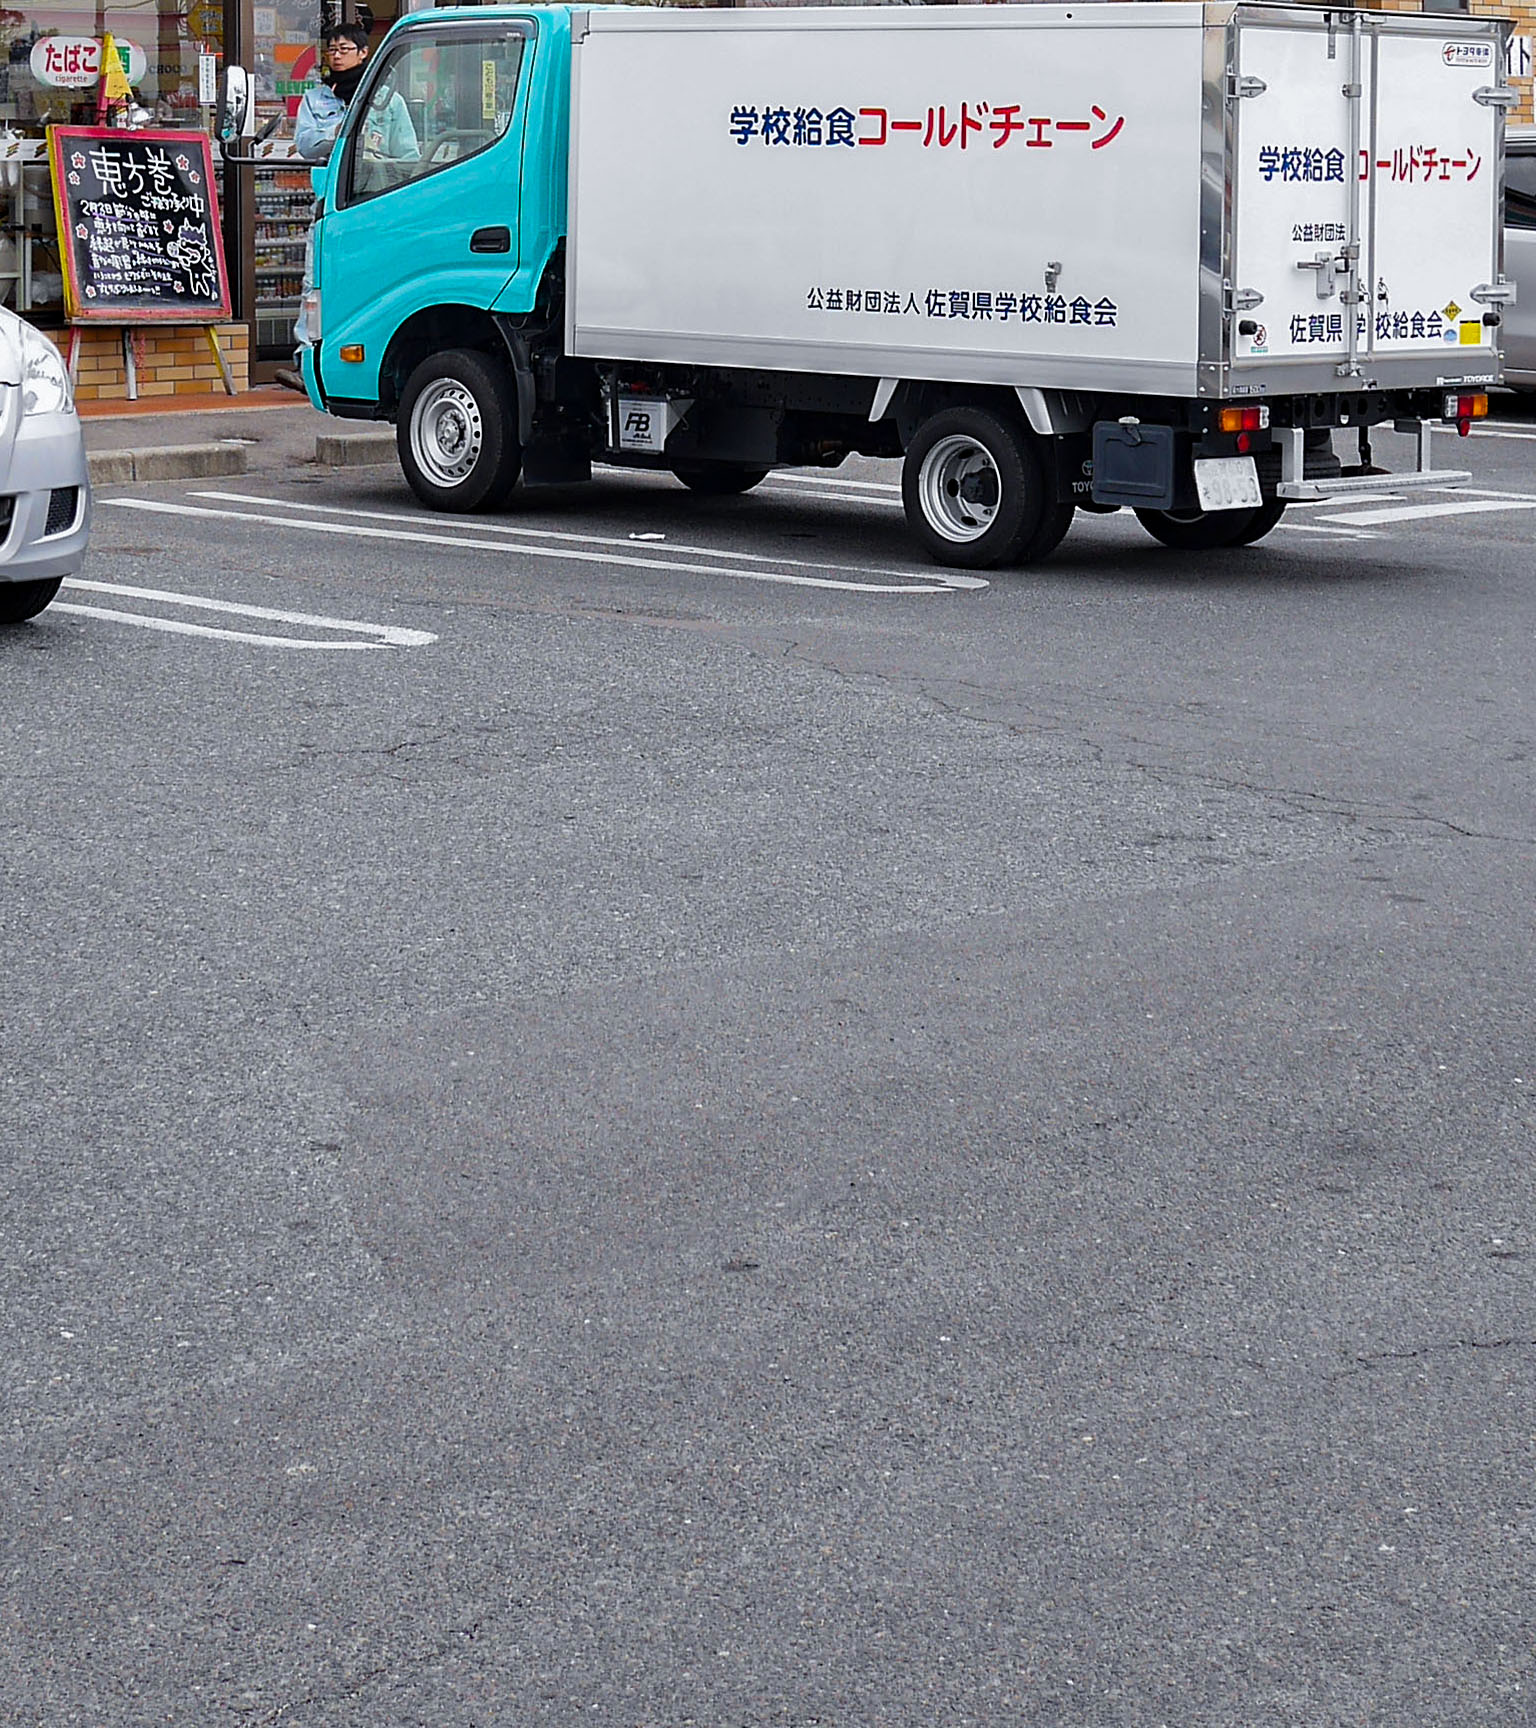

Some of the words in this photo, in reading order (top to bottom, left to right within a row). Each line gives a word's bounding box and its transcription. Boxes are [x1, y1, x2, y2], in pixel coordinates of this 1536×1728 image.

[45, 43, 98, 73] たばこ
[55, 75, 88, 84] cigarette
[89, 146, 175, 198] 恵方巻
[1292, 223, 1346, 242] 公益財団法
